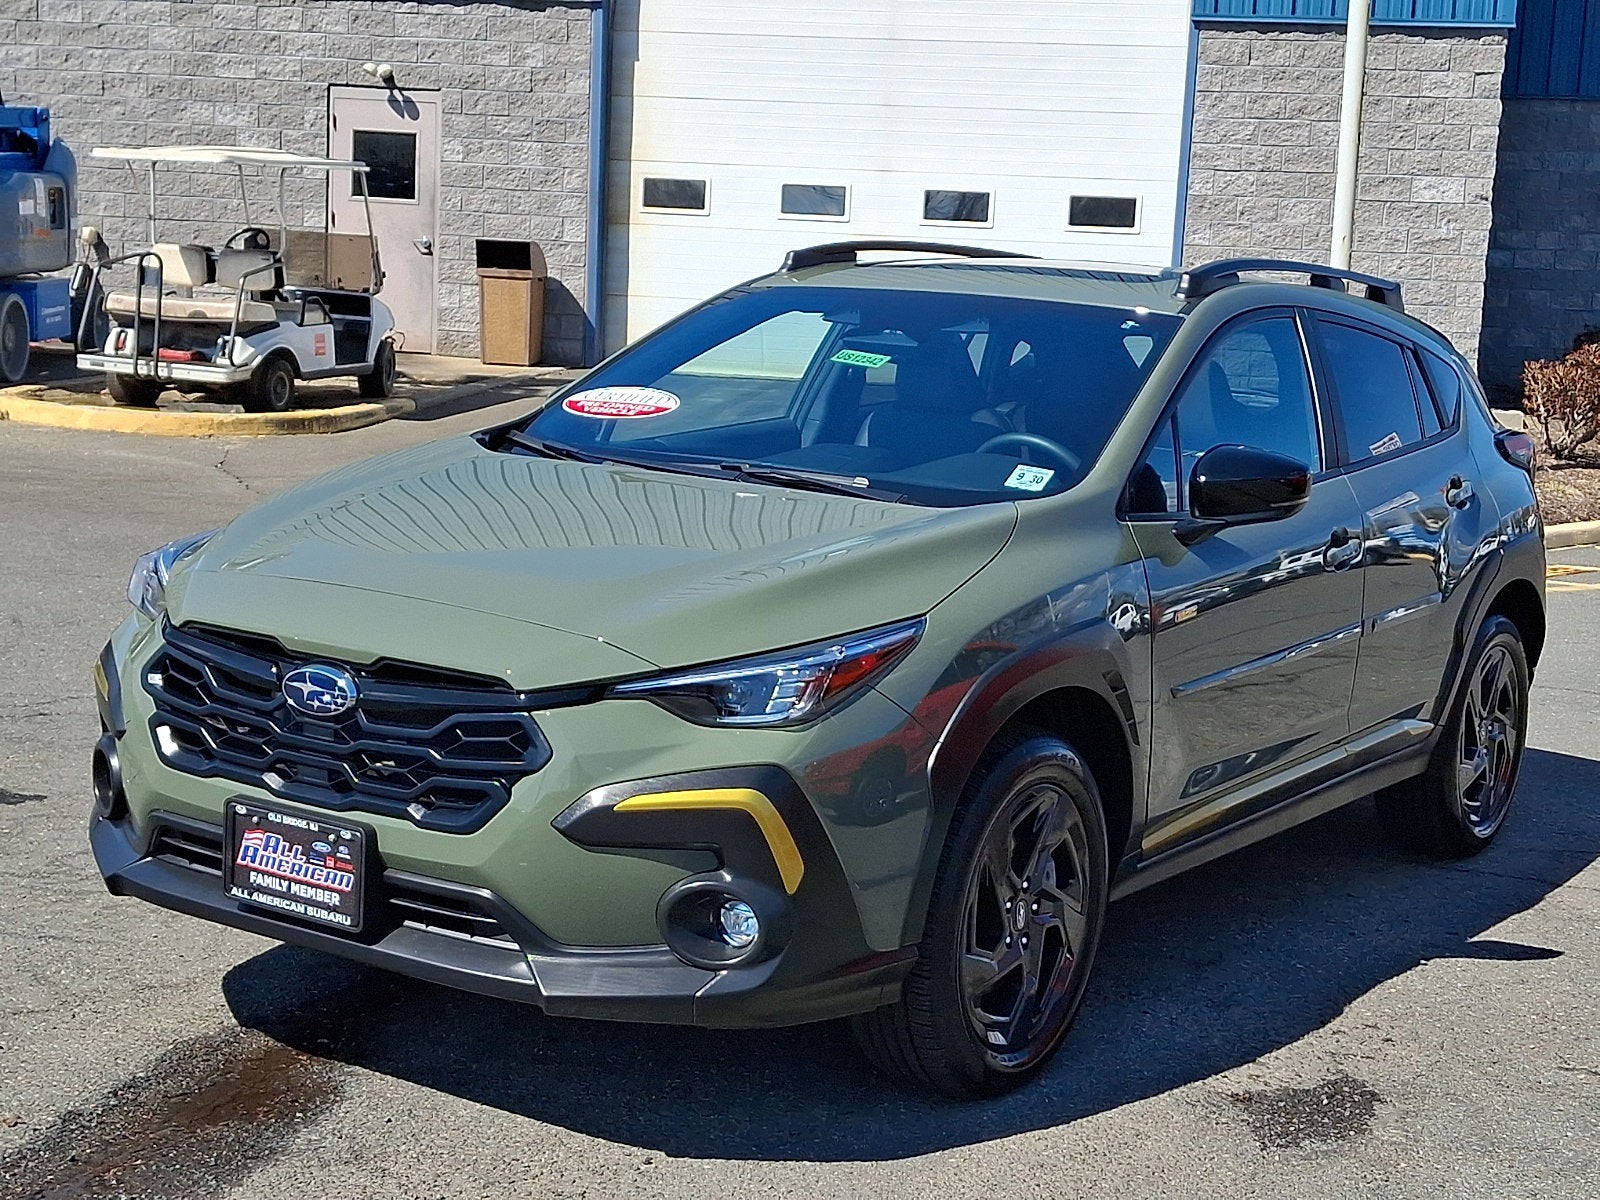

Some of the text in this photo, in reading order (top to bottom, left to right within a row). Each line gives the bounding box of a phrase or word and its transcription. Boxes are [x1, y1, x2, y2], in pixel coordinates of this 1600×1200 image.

[1016, 472, 1026, 481] 9
[1029, 474, 1044, 484] 30
[230, 886, 351, 926] ALL AMERICAN SUBARU
[249, 871, 340, 906] FAMILY MEMBER
